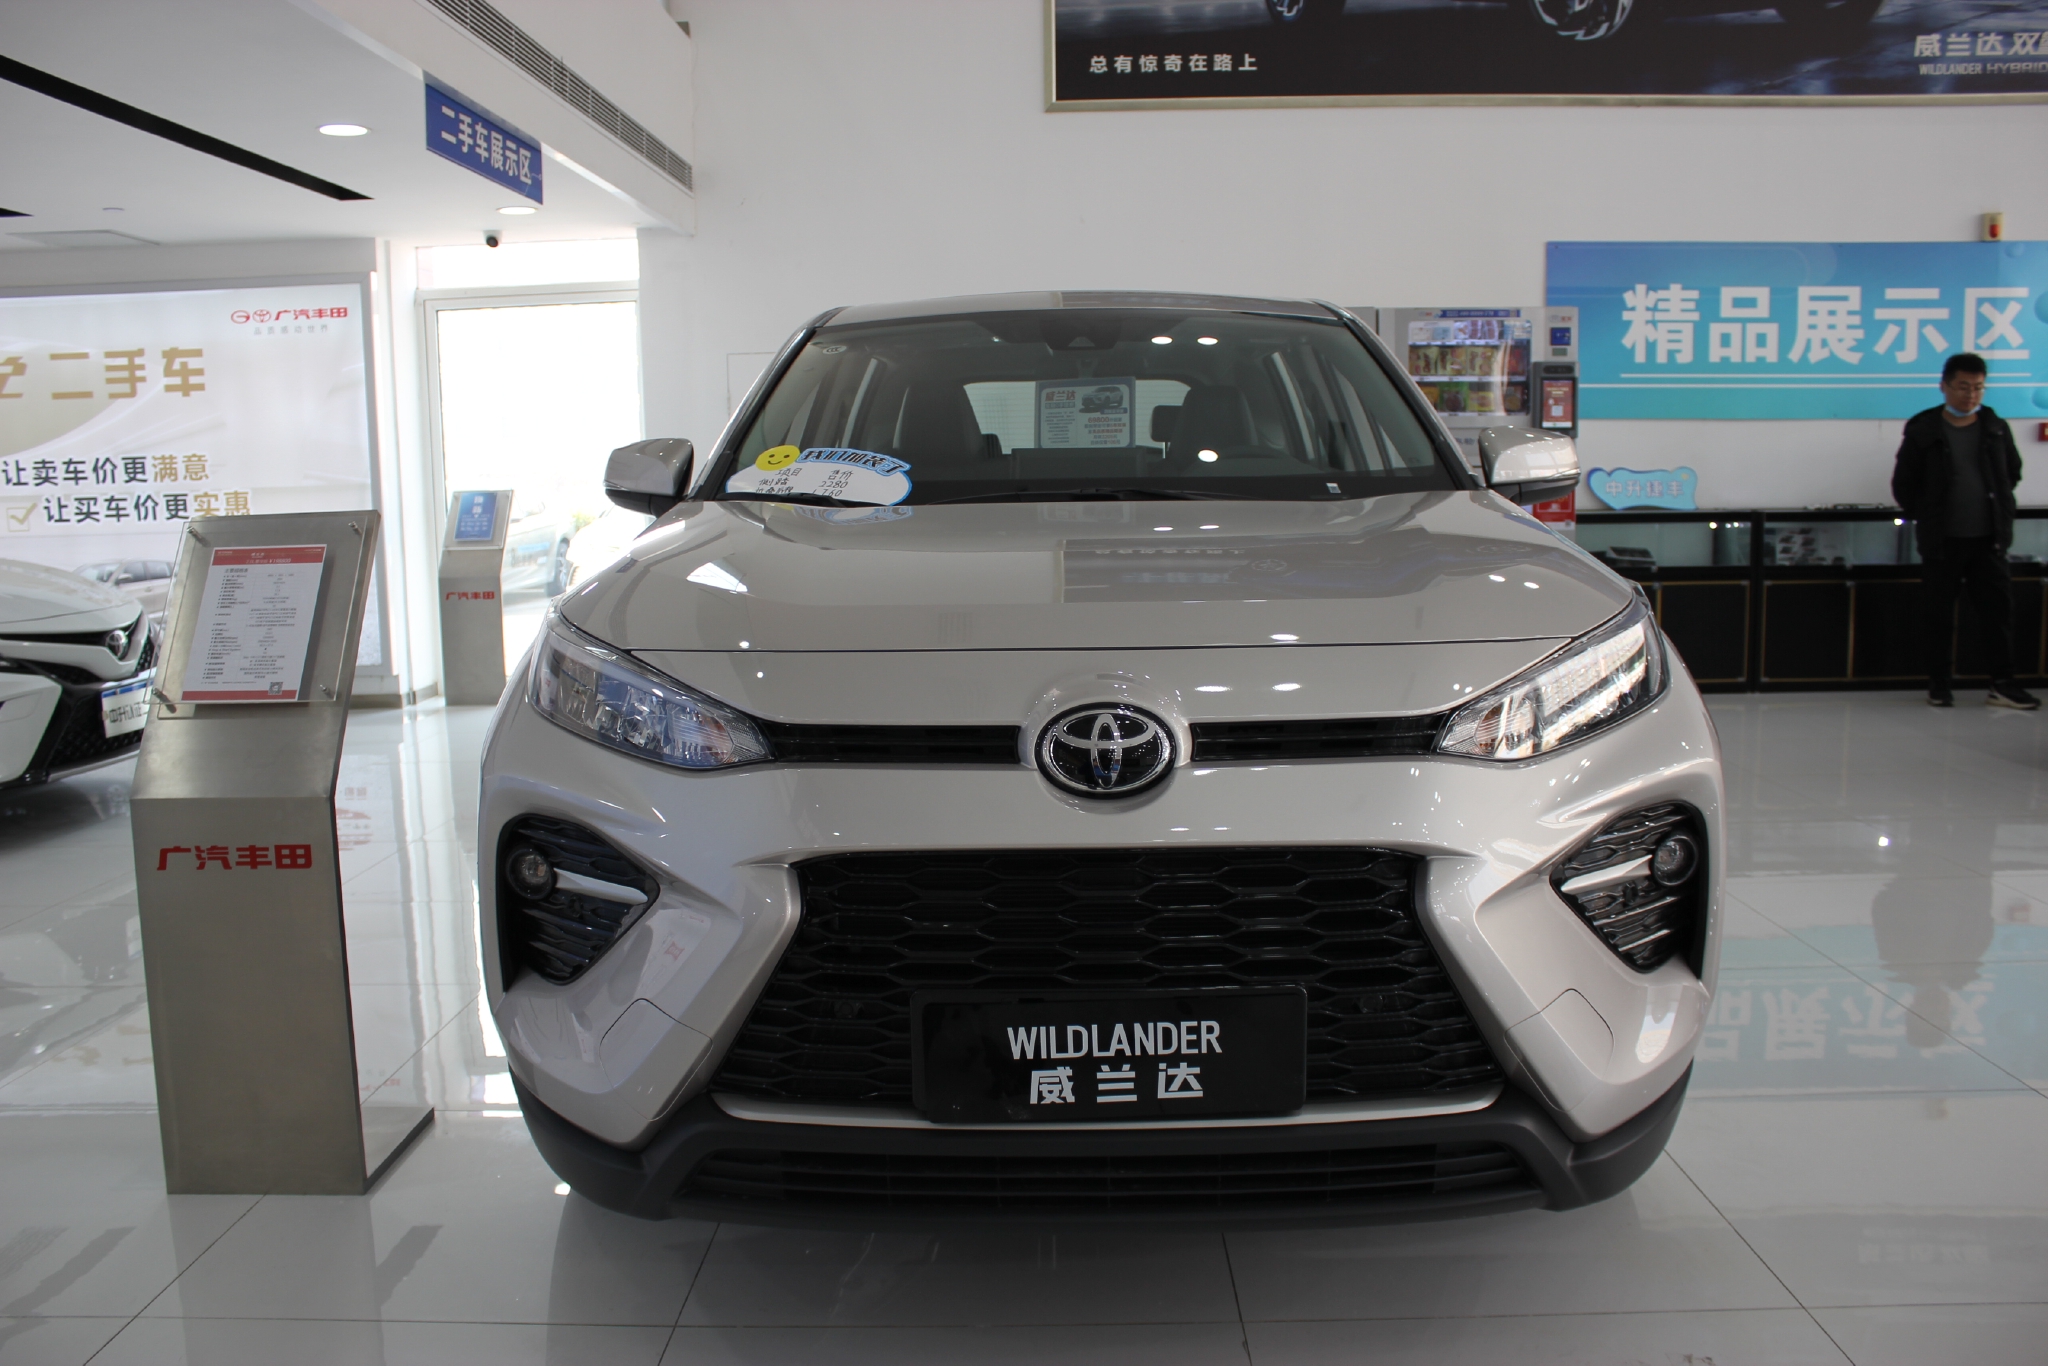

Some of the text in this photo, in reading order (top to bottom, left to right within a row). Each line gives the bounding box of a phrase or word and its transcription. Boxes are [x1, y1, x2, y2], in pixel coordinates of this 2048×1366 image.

[1913, 31, 2048, 57] 威兰达双
[1089, 53, 1258, 74] 总有惊奇在路上
[1918, 62, 1983, 75] WILDLANDER
[441, 104, 532, 185] 二手车展示区
[274, 307, 348, 321] 广汽丰田
[1621, 283, 2031, 365] 精品展示区
[1, 453, 210, 487] 让卖车价更满意
[818, 480, 849, 489] 2280
[43, 490, 250, 523] 让买车价更实惠
[157, 844, 312, 871] 广汽丰田
[1007, 1020, 1223, 1060] WILDLANDER
[1030, 1062, 1204, 1105] 威兰达
